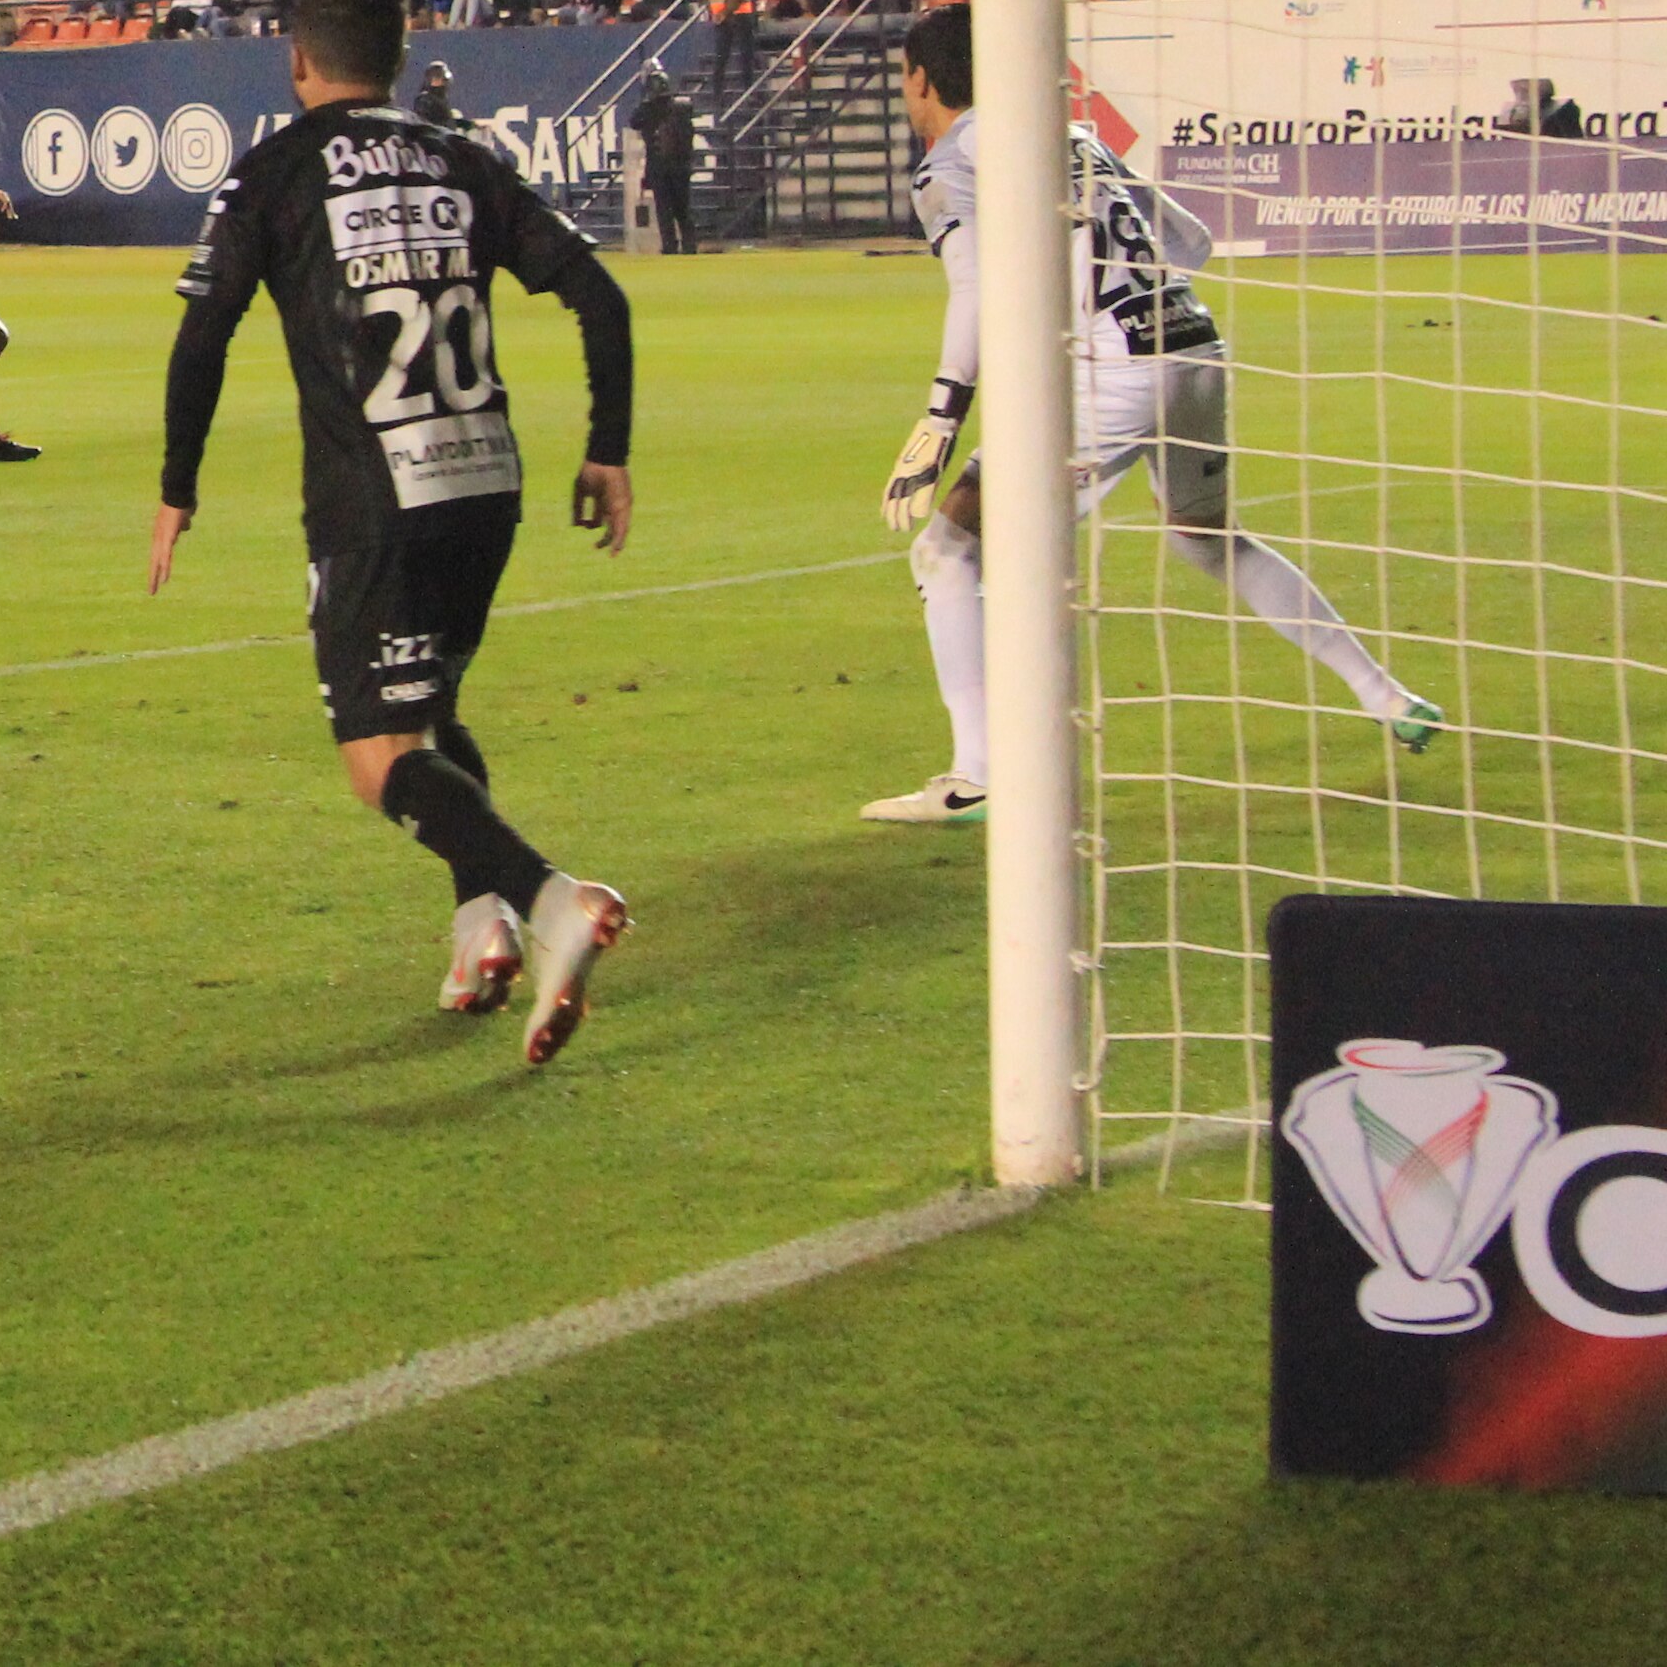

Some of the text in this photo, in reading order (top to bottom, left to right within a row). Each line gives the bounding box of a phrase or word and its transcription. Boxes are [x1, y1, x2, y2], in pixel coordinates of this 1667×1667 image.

[320, 135, 449, 187] Búfalo
[1255, 197, 1321, 227] VIENDO
[1323, 196, 1358, 226] POR
[1361, 195, 1383, 226] EL
[1386, 194, 1459, 226] FUTURO
[1461, 194, 1484, 225] DE
[1486, 193, 1527, 224] LOS
[362, 285, 507, 425] 20
